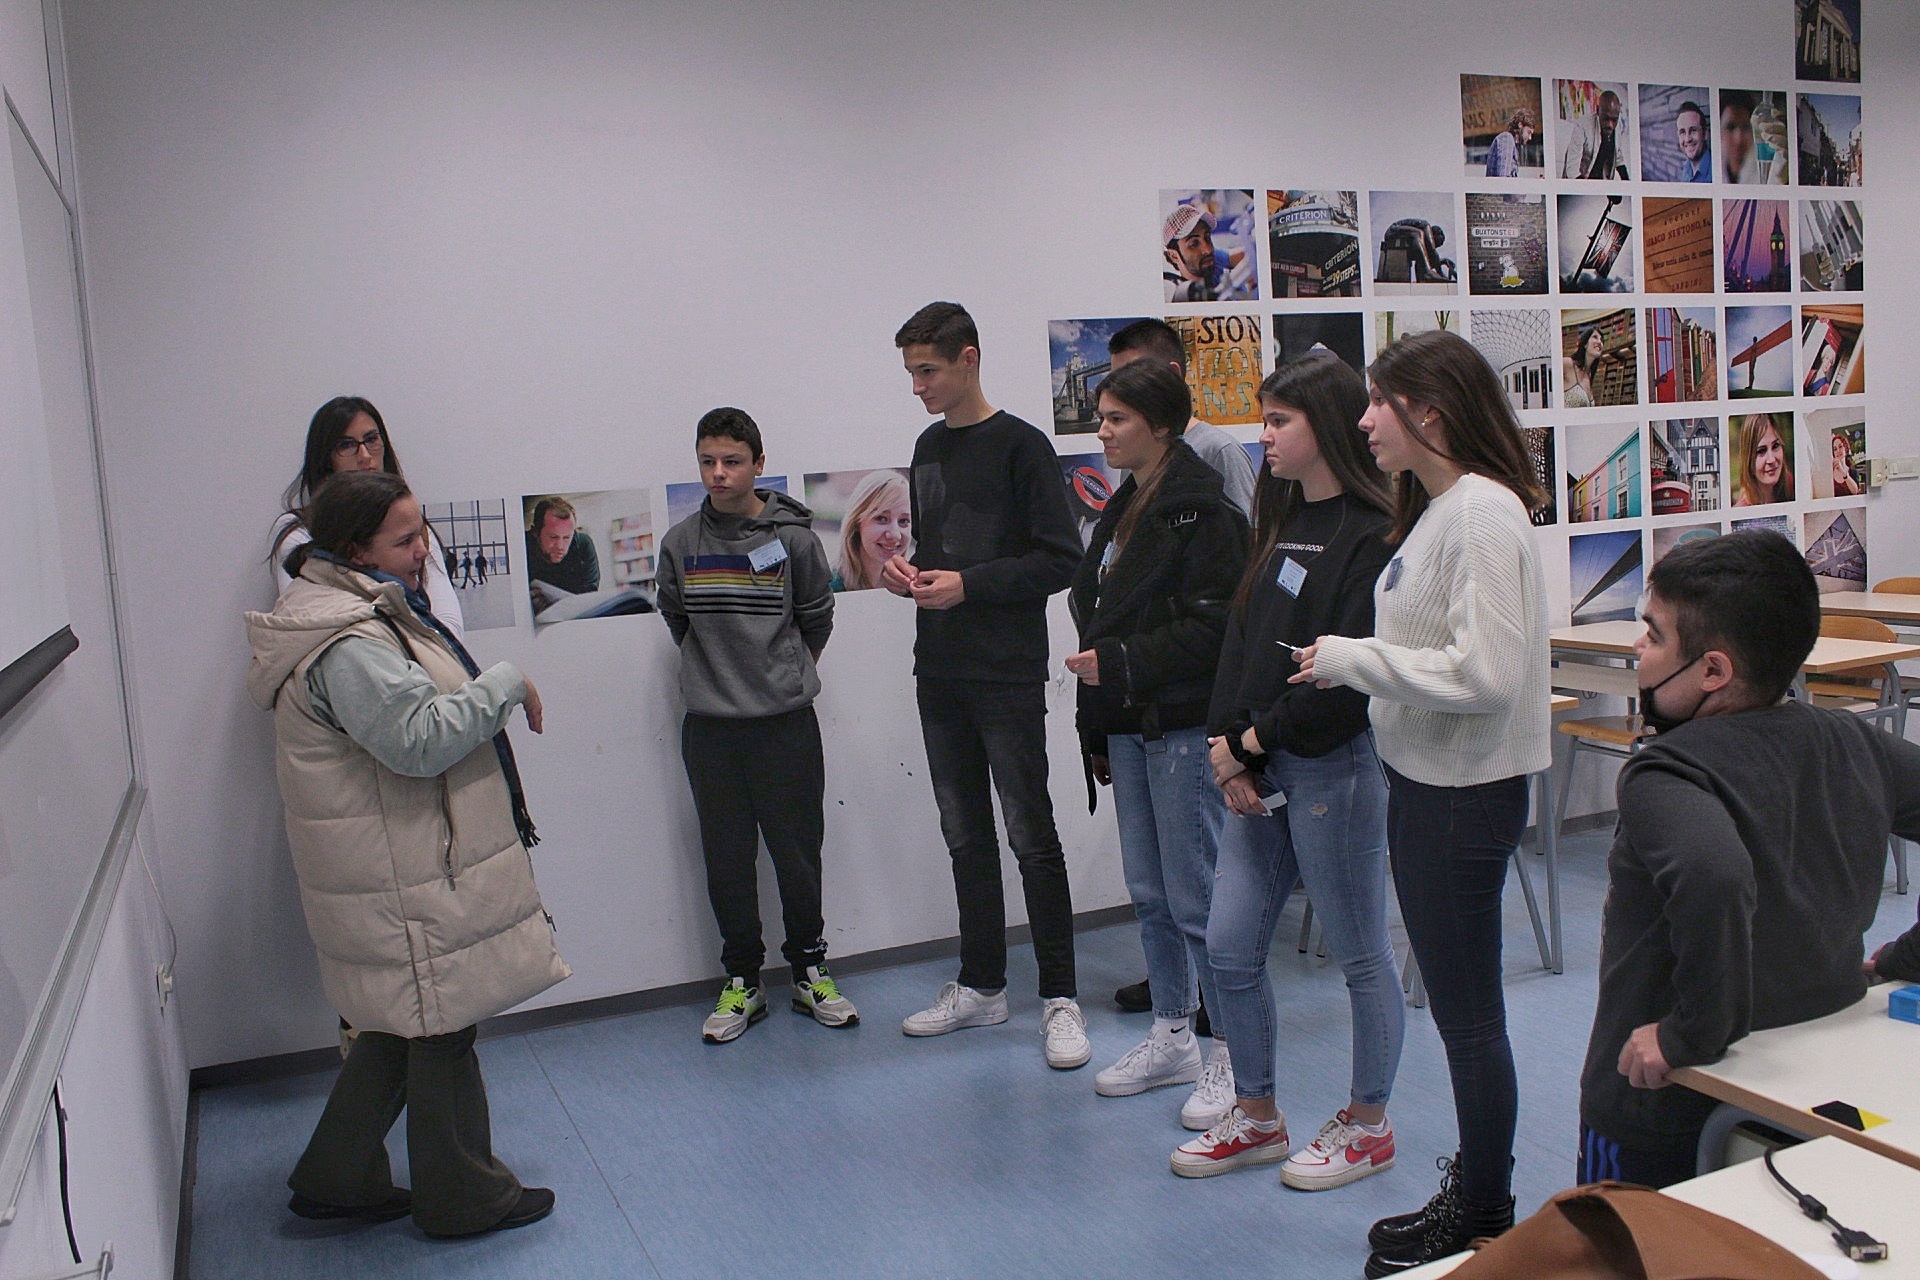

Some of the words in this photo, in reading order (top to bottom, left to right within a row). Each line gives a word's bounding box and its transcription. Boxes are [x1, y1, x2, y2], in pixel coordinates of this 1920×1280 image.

[1279, 209, 1327, 224] CRITERION
[1475, 228, 1499, 236] BUXTON
[1325, 240, 1358, 271] CRITERION
[1305, 544, 1324, 552] GOOD
